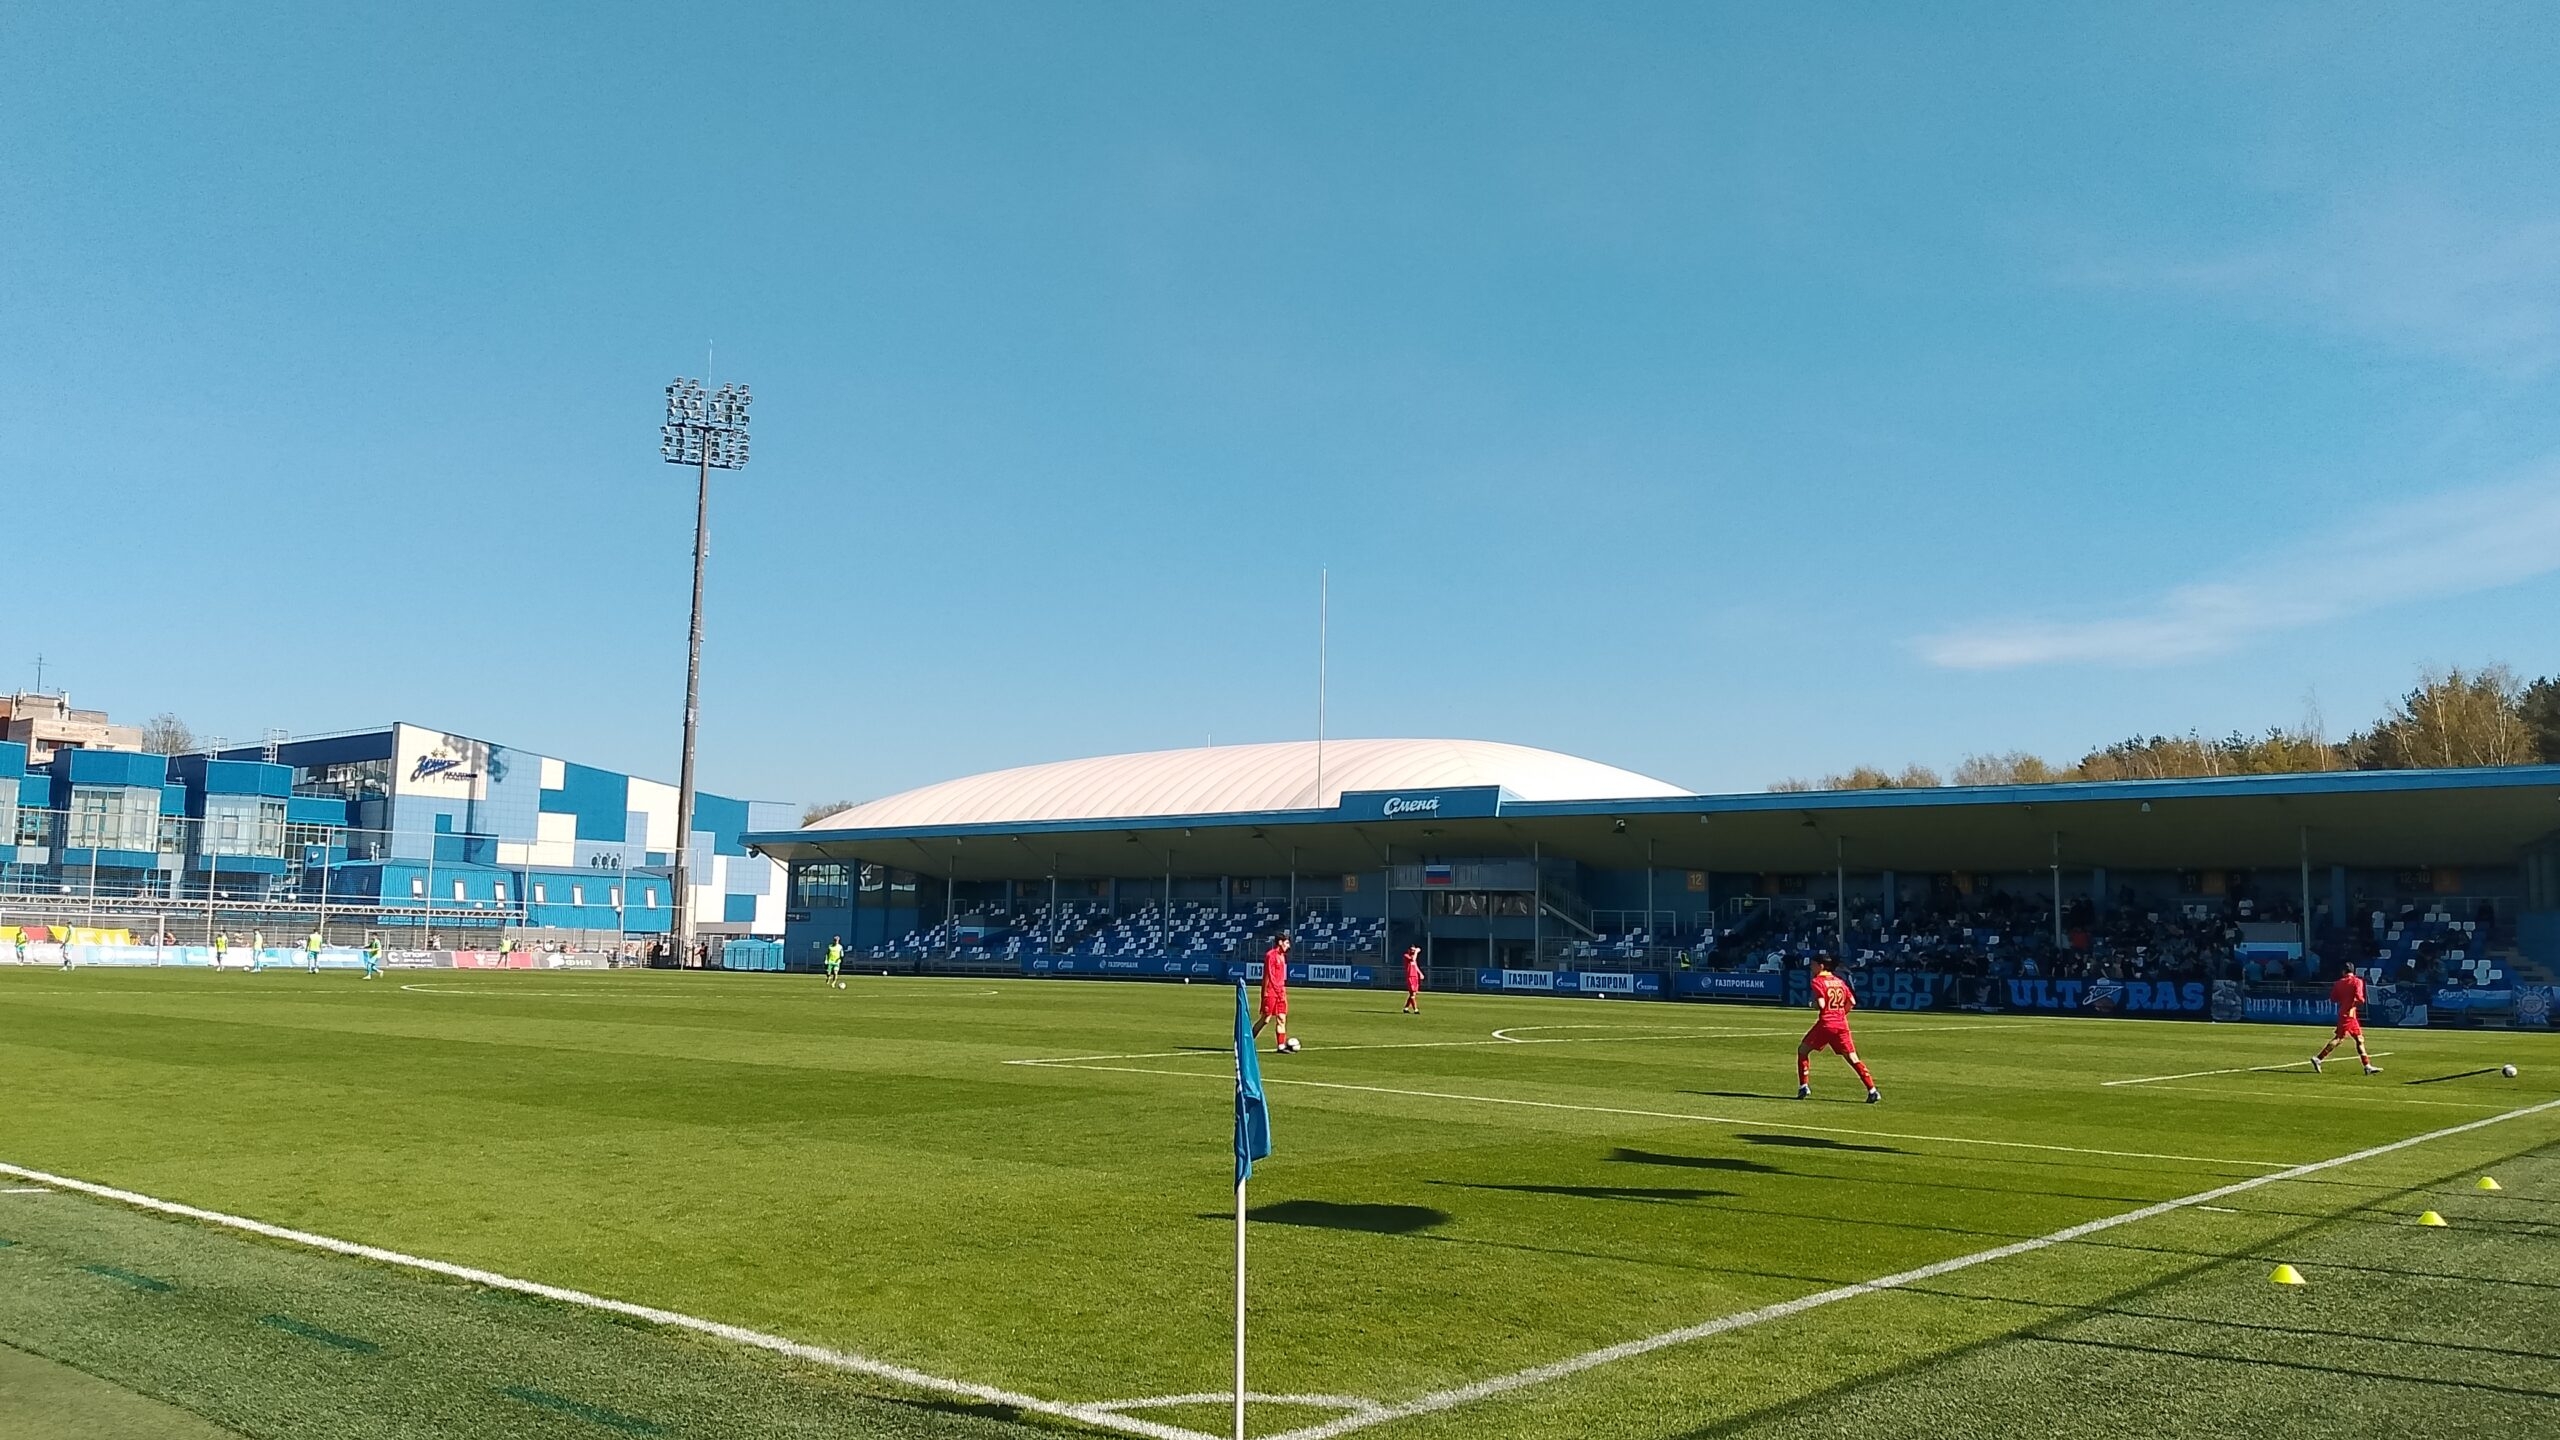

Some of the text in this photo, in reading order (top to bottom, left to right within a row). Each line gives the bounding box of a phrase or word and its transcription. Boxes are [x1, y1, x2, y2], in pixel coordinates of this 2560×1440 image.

[1383, 797, 1441, 816] Смена
[1346, 875, 1356, 887] 13
[1690, 873, 1702, 886] 12
[1313, 967, 1347, 979] ГАЗПРОМ
[1508, 973, 1548, 986] ГАЗПРОМ
[1585, 975, 1627, 989] ГАЗПРОМ
[1715, 978, 1765, 989] ГАЗПРОМБАНК
[1827, 986, 1845, 1011] 22
